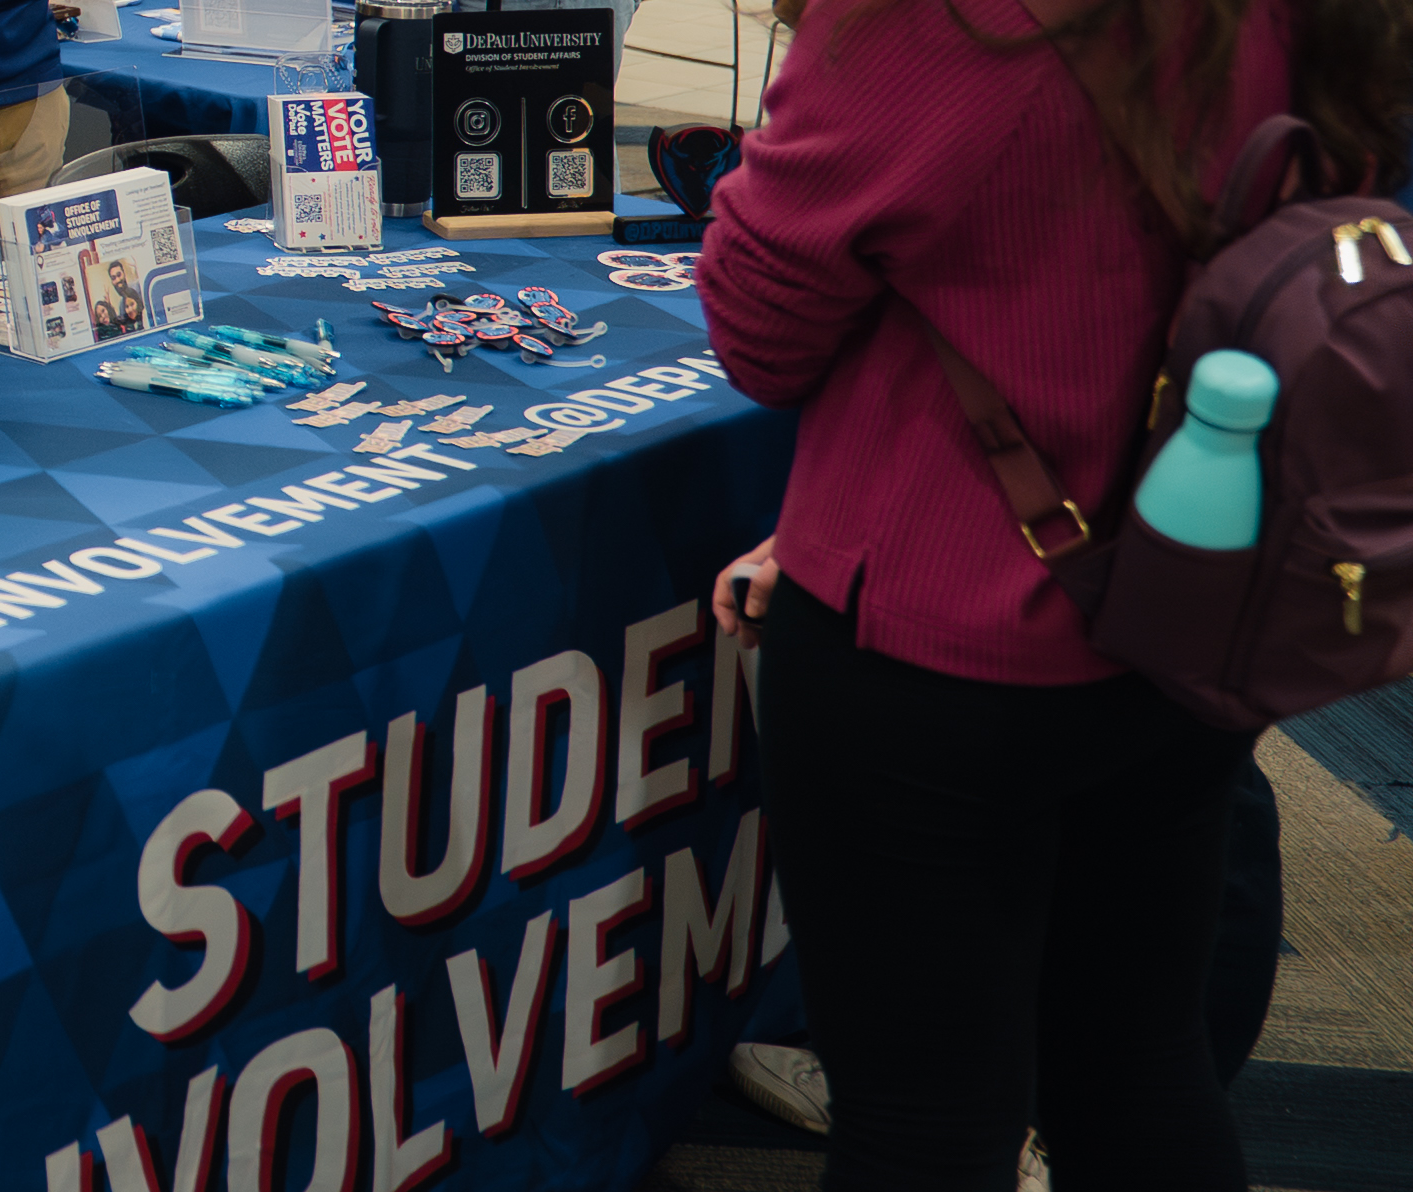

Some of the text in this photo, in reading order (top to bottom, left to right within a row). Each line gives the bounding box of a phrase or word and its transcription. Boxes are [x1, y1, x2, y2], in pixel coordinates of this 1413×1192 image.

[466, 32, 602, 49] DEPAUL UNIVERSITY
[465, 53, 500, 62] DIVISION
[513, 52, 548, 61] STUDENT
[550, 51, 581, 60] AFFAIRS
[465, 65, 485, 73] Office
[287, 104, 298, 136] DePaul
[296, 104, 310, 136] Vote
[310, 101, 334, 171] MATTERS
[327, 102, 354, 164] VOTE
[347, 99, 373, 164] YOUR
[64, 199, 101, 218] OFFICE OF
[66, 211, 100, 228] STUDENT
[68, 218, 119, 239] INVOLVEMENT
